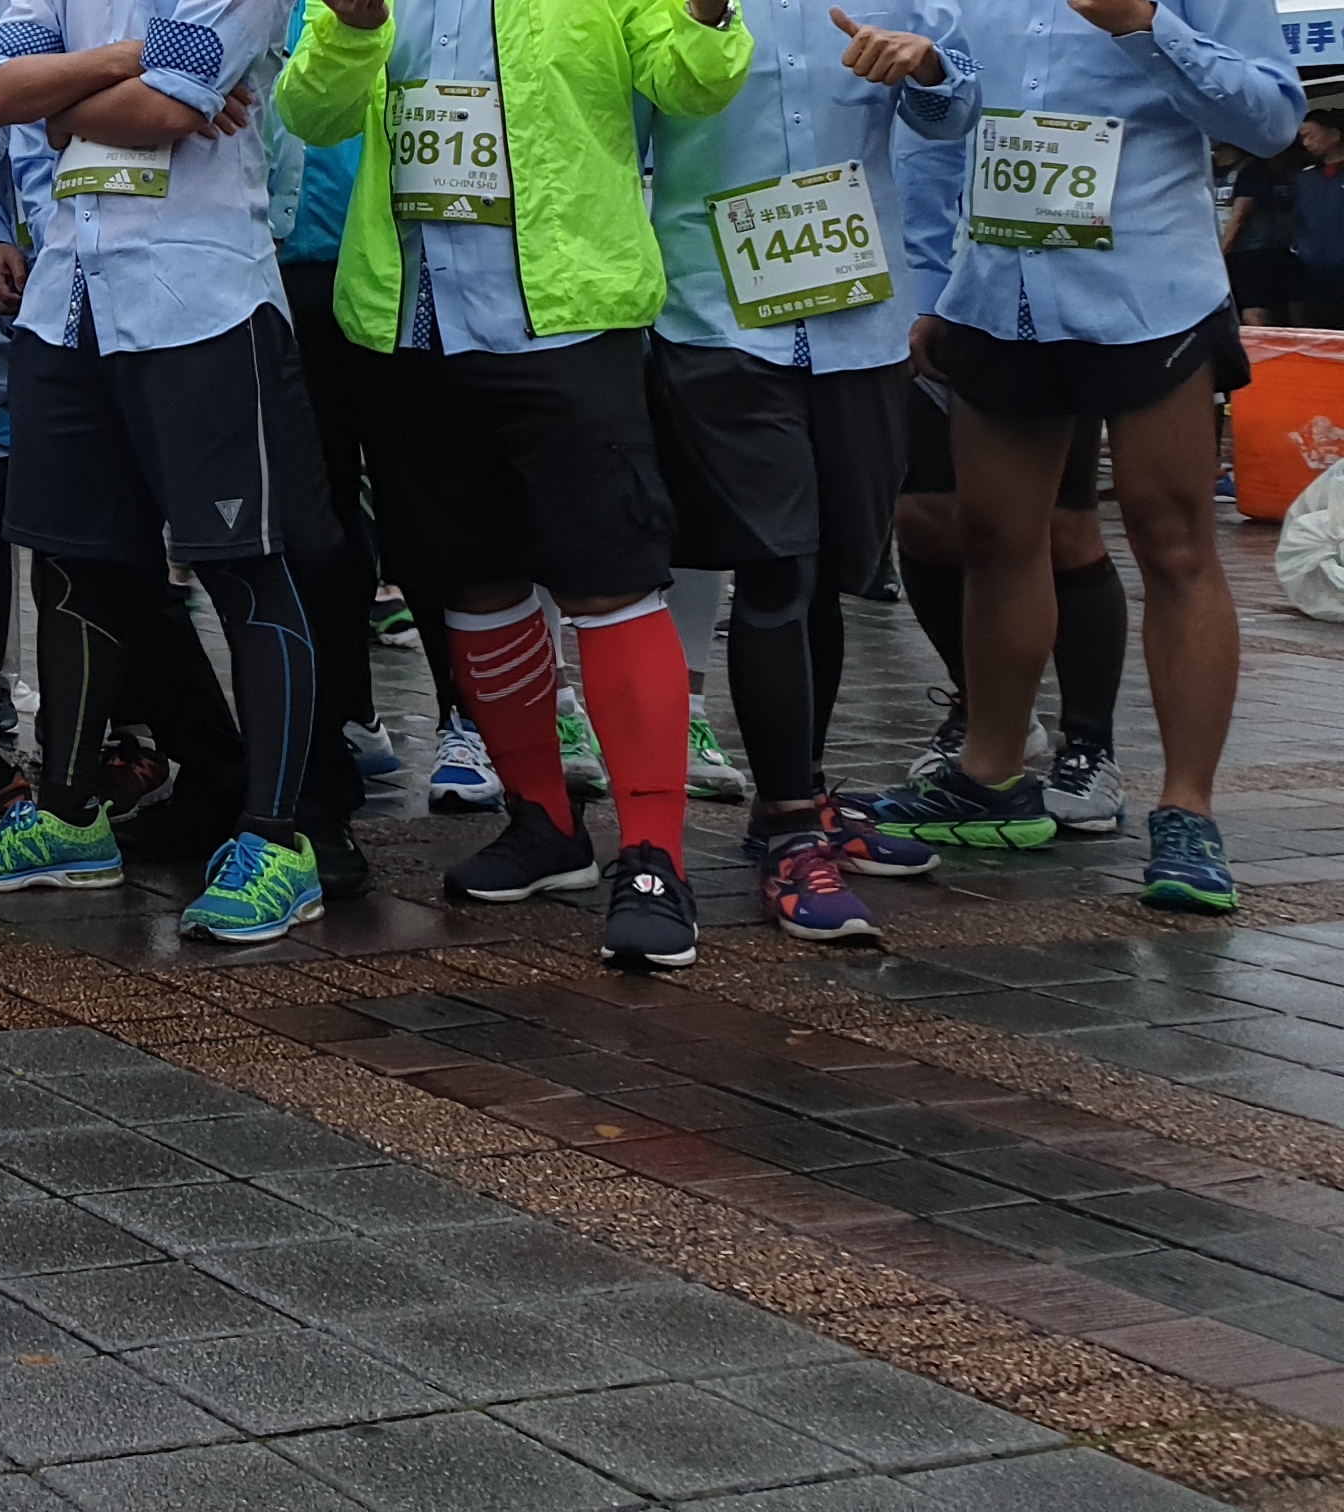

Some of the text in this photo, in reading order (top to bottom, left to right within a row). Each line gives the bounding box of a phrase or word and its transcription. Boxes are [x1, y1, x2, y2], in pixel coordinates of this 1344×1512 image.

[392, 130, 497, 167] 19818
[981, 156, 1097, 198] 16978
[760, 199, 828, 223] 半馬男子組
[737, 214, 869, 271] 14456
